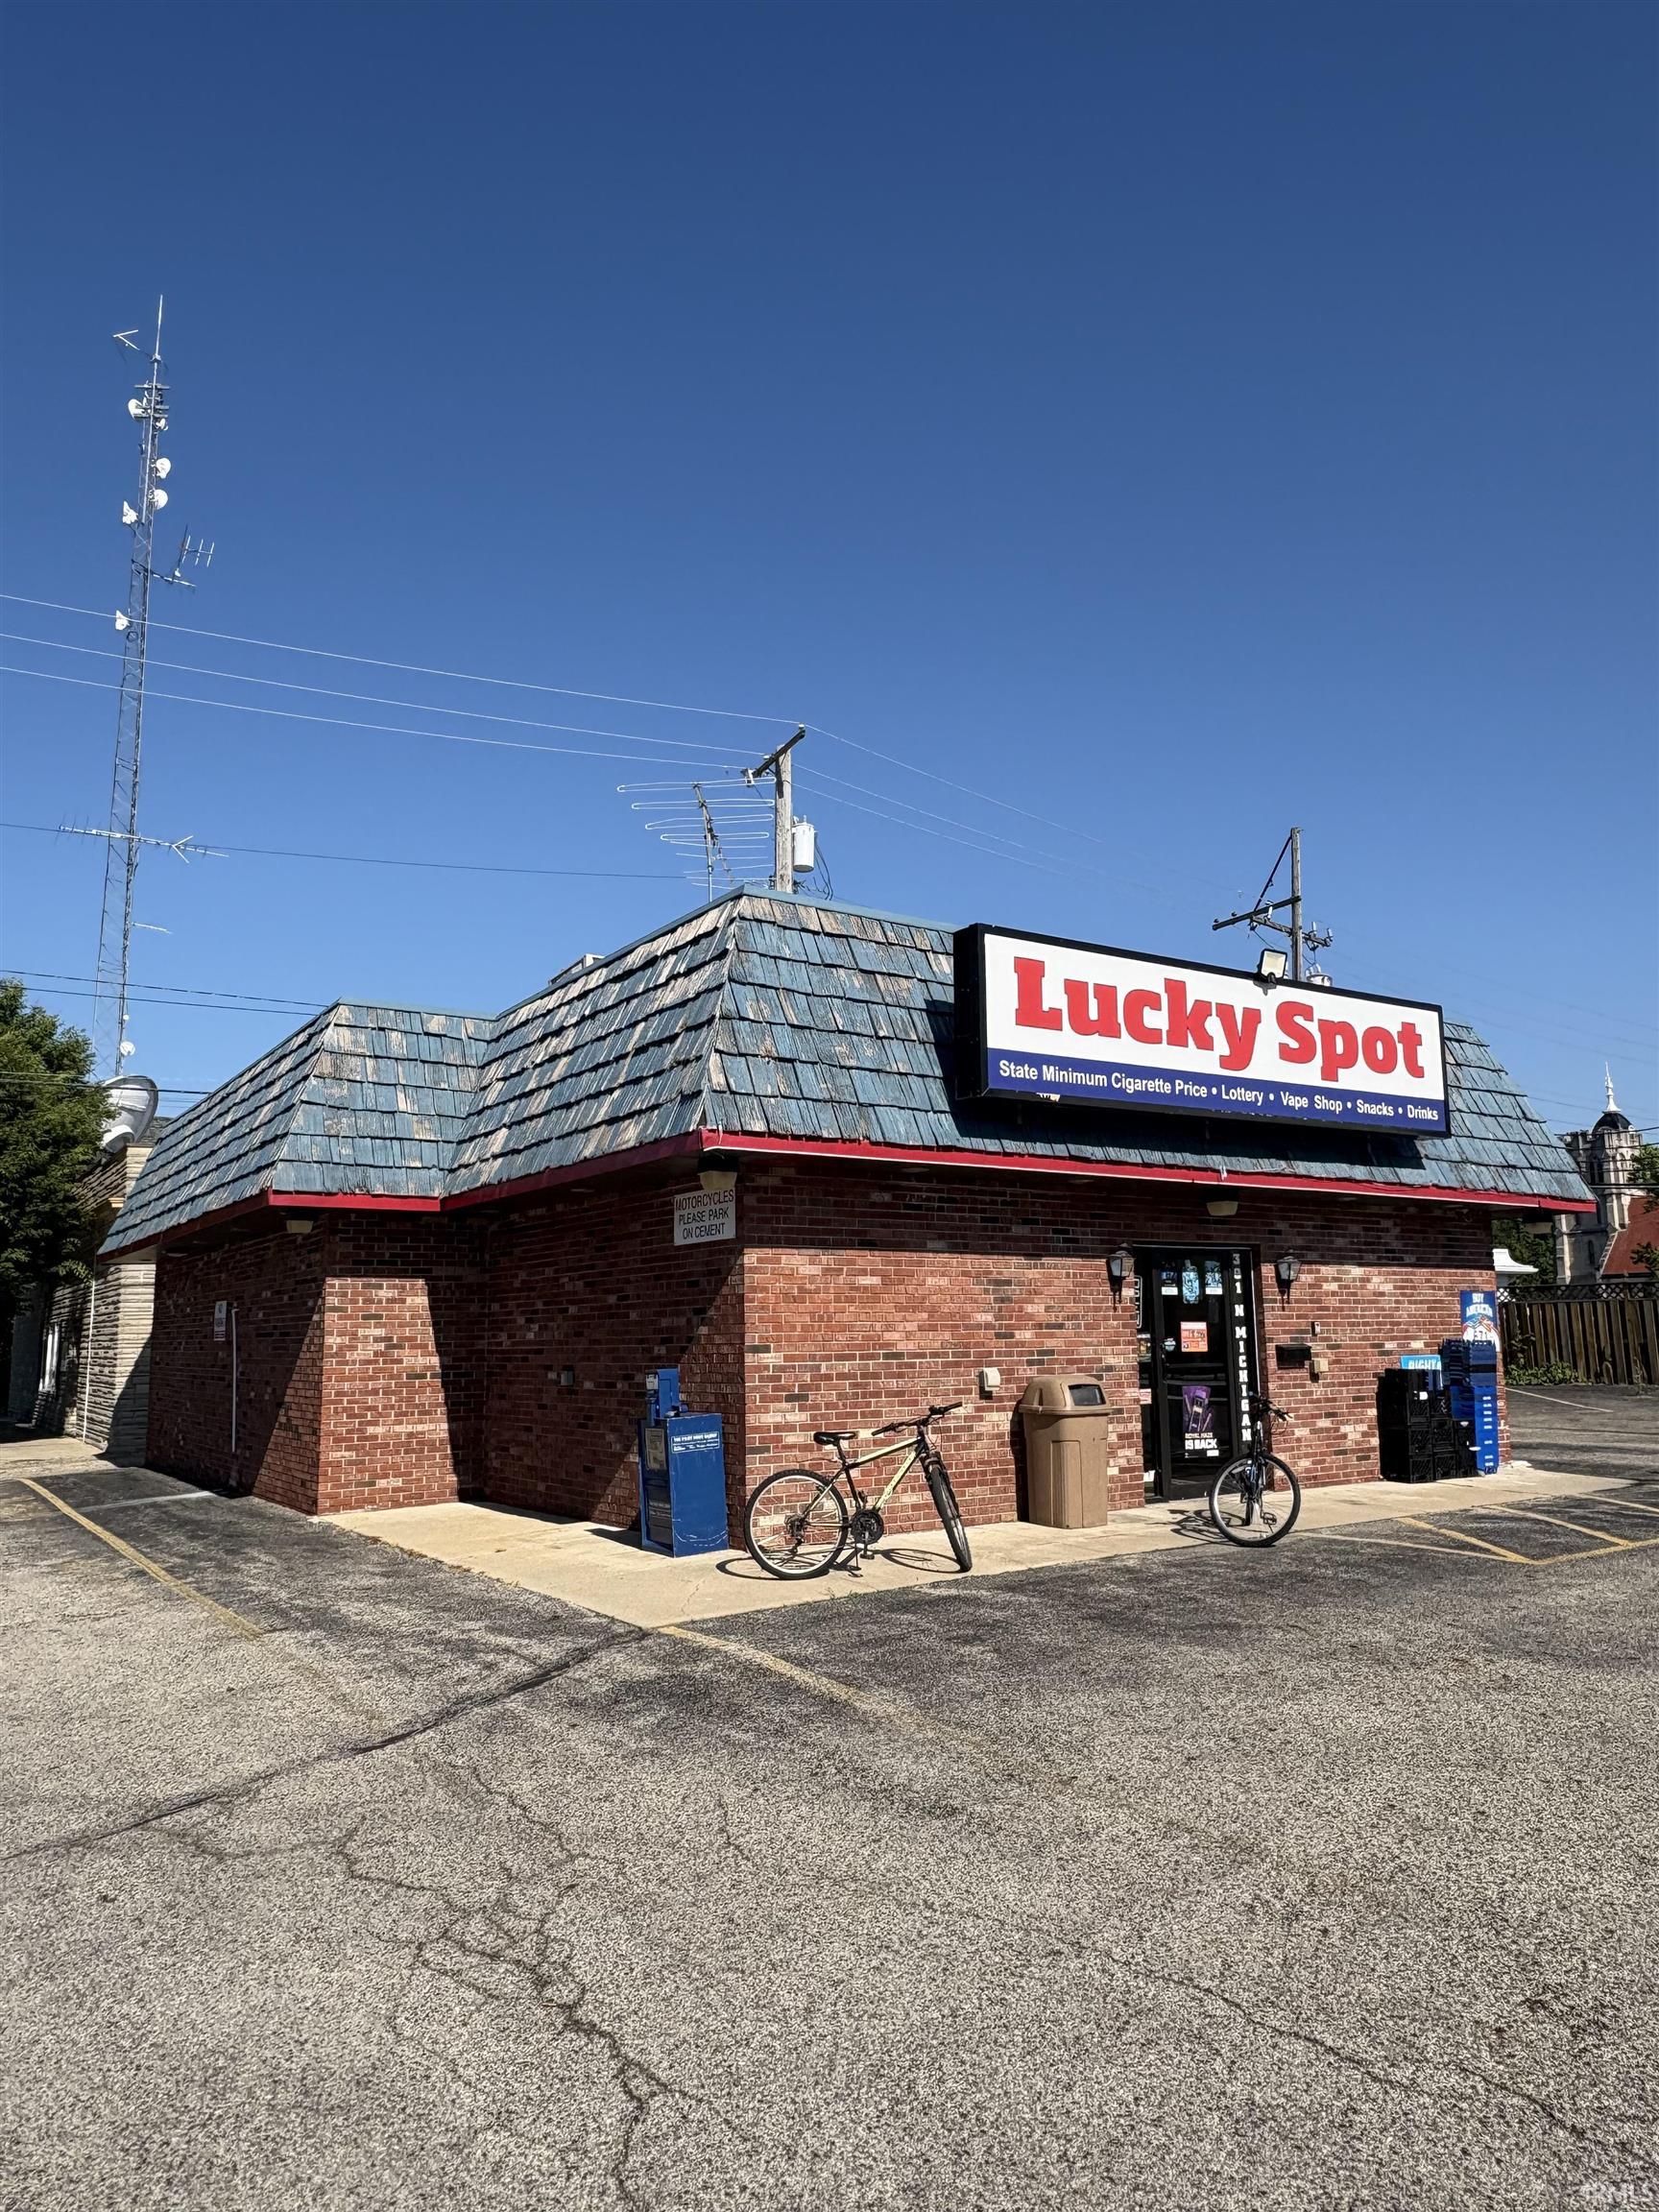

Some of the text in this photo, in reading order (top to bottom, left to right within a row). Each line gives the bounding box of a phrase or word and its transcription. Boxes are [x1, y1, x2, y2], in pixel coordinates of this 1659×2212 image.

[1014, 955, 1426, 1082] Lucky Spot
[999, 1059, 1439, 1120] State Minimum Cigarette Price Lottery Vape Shop Snacks Drinks
[675, 1189, 734, 1212] MOTORCYCLES
[679, 1207, 730, 1225] PLEASE PARK
[683, 1222, 726, 1239] ON CEMENT
[1235, 1326, 1252, 1441] MICHIGAN
[1194, 1438, 1217, 1450] BACK
